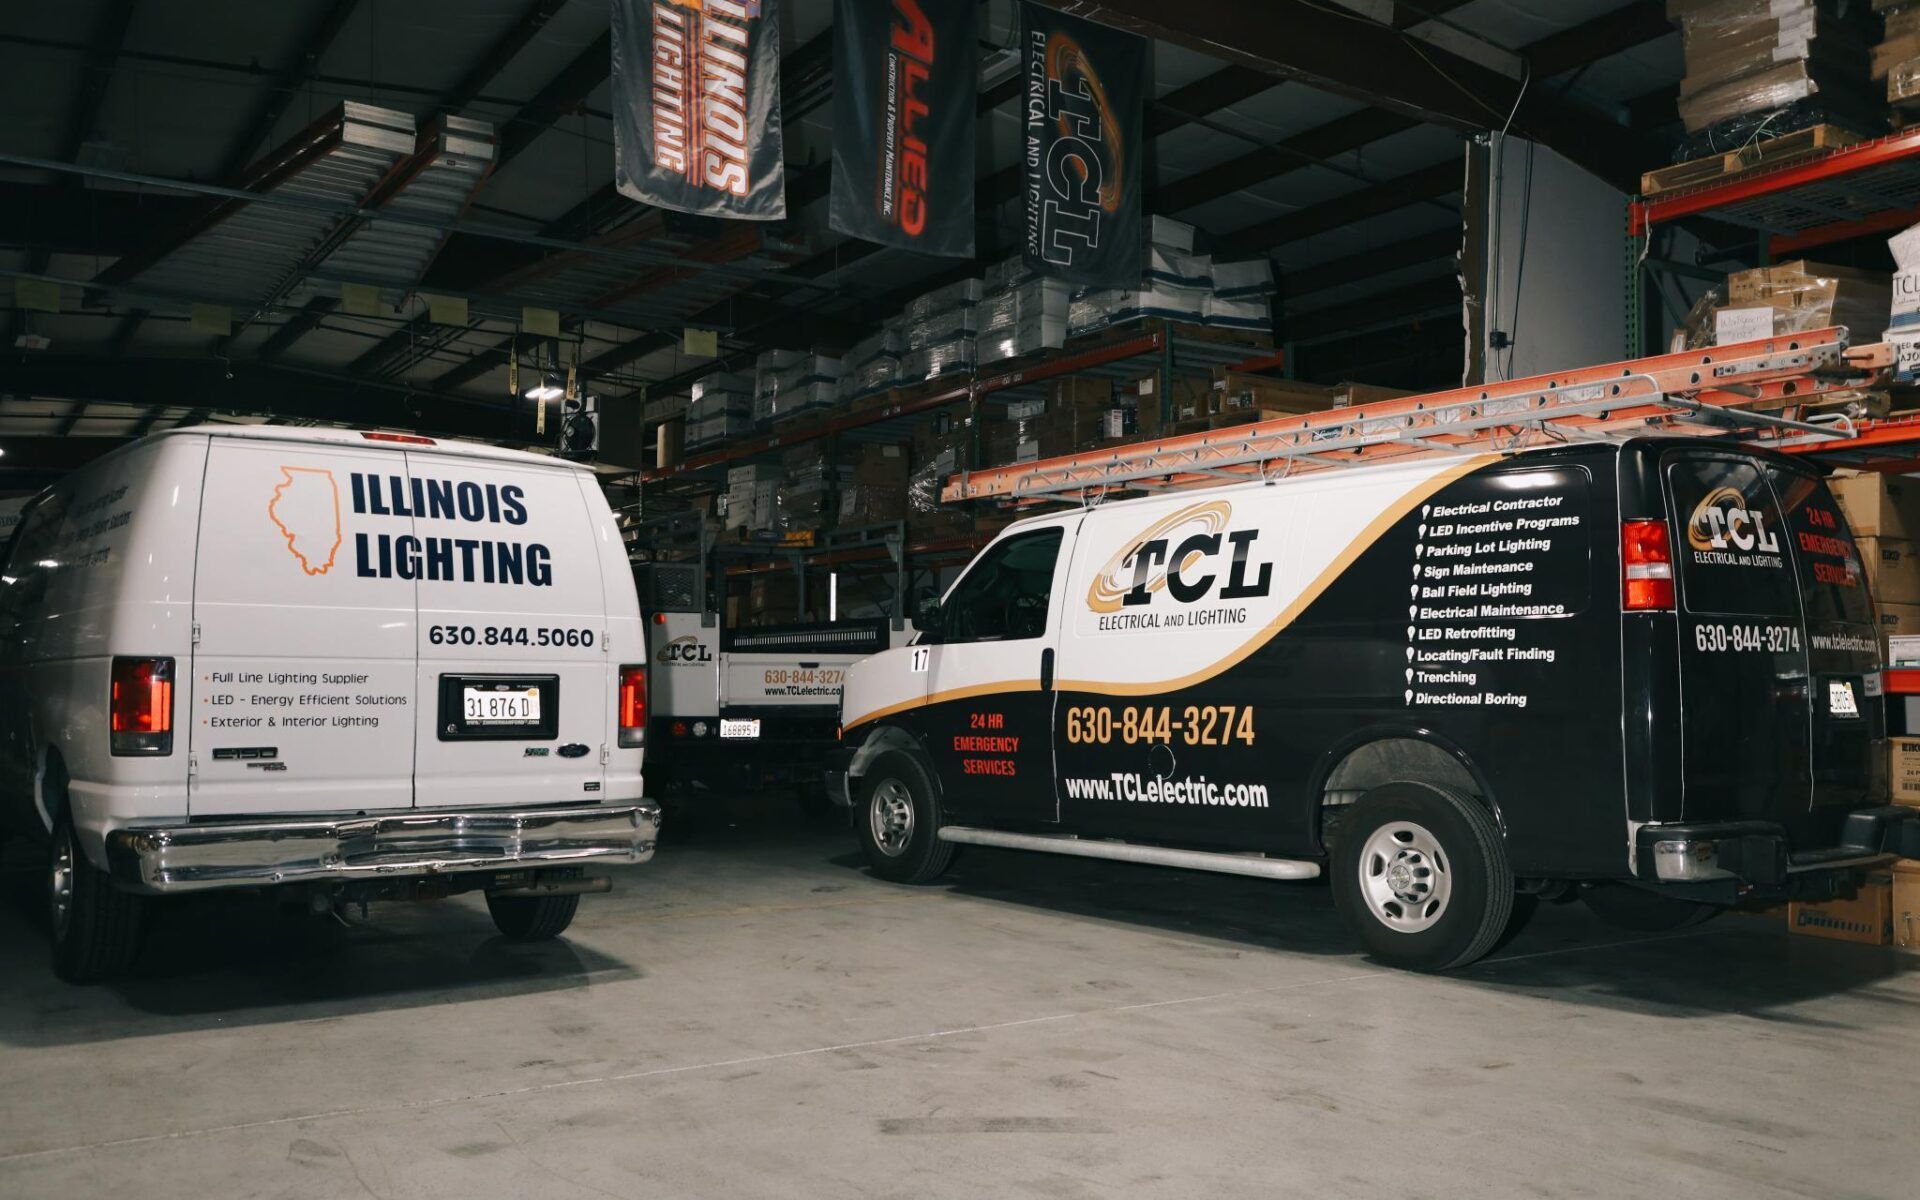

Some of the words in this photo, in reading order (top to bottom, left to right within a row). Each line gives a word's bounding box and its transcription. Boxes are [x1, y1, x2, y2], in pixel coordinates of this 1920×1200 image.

[653, 2, 687, 175] LIGHTING
[1028, 30, 1045, 131] ELECTRICAL
[701, 0, 754, 197] LLINOIS
[890, 0, 934, 236] ALLIED
[1027, 136, 1041, 168] AND
[1041, 77, 1103, 266] TCL
[350, 473, 527, 525] ILLINOIS
[1432, 501, 1491, 518] Electrical
[1493, 496, 1564, 512] Contractor
[1429, 525, 1454, 537] LED
[1456, 520, 1513, 535] Incentive
[1516, 515, 1580, 532] Programs
[1806, 506, 1821, 528] 24
[1701, 506, 1780, 553] TCL
[1426, 543, 1473, 558] Parking
[1475, 541, 1496, 554] Lot
[1499, 537, 1552, 552] Lighting
[355, 533, 552, 586] LIGHTING
[1122, 529, 1273, 606] TCL
[1423, 565, 1451, 580] Sign
[1453, 560, 1534, 576] Maintenance
[1694, 551, 1738, 566] ELECTRICAL
[1739, 556, 1752, 566] AND
[1752, 554, 1783, 569] LIGHTING
[1421, 586, 1446, 598] Ball
[1447, 584, 1479, 597] Field
[1480, 581, 1533, 597] Lighting
[1098, 613, 1161, 631] ELECTRICAL
[1163, 614, 1184, 627] AND
[1187, 607, 1247, 626] LIGHTING
[1420, 605, 1478, 620] Electrical
[1480, 603, 1566, 617] Maintenance
[429, 625, 594, 647] 630.844.5060
[1418, 627, 1443, 640] LED
[1445, 626, 1517, 641] Retrofitting
[1695, 623, 1800, 653] 630-844-3274
[1811, 632, 1877, 653] www.tclelectric.com
[668, 643, 712, 661] TCL
[914, 649, 928, 671] 17
[1417, 648, 1504, 664] Locating/Fault
[1507, 647, 1556, 662] Finding
[212, 673, 233, 684] Full
[239, 673, 263, 684] Line
[268, 674, 317, 685] Lighting
[322, 674, 368, 685] Supplier
[1417, 670, 1477, 686] Trenching
[211, 695, 234, 705] LED
[251, 696, 294, 707] Energy
[299, 695, 350, 706] Efficient
[355, 695, 407, 706] Solutions
[467, 698, 484, 718] 31
[489, 698, 516, 718] 876
[521, 698, 530, 717] D
[1415, 692, 1483, 705] Directional
[1485, 692, 1528, 708] Boring
[211, 717, 262, 728] Exterior
[268, 717, 276, 727] &
[282, 717, 327, 727] Interior
[332, 717, 379, 728] Lighting
[970, 713, 986, 729] 24
[988, 713, 1004, 729] HR
[1066, 705, 1256, 746] 630-844-3274
[953, 736, 1019, 752] EMERGENCY
[963, 759, 1015, 777] SERVICES
[1065, 772, 1270, 808] www.TCLelectric.com
